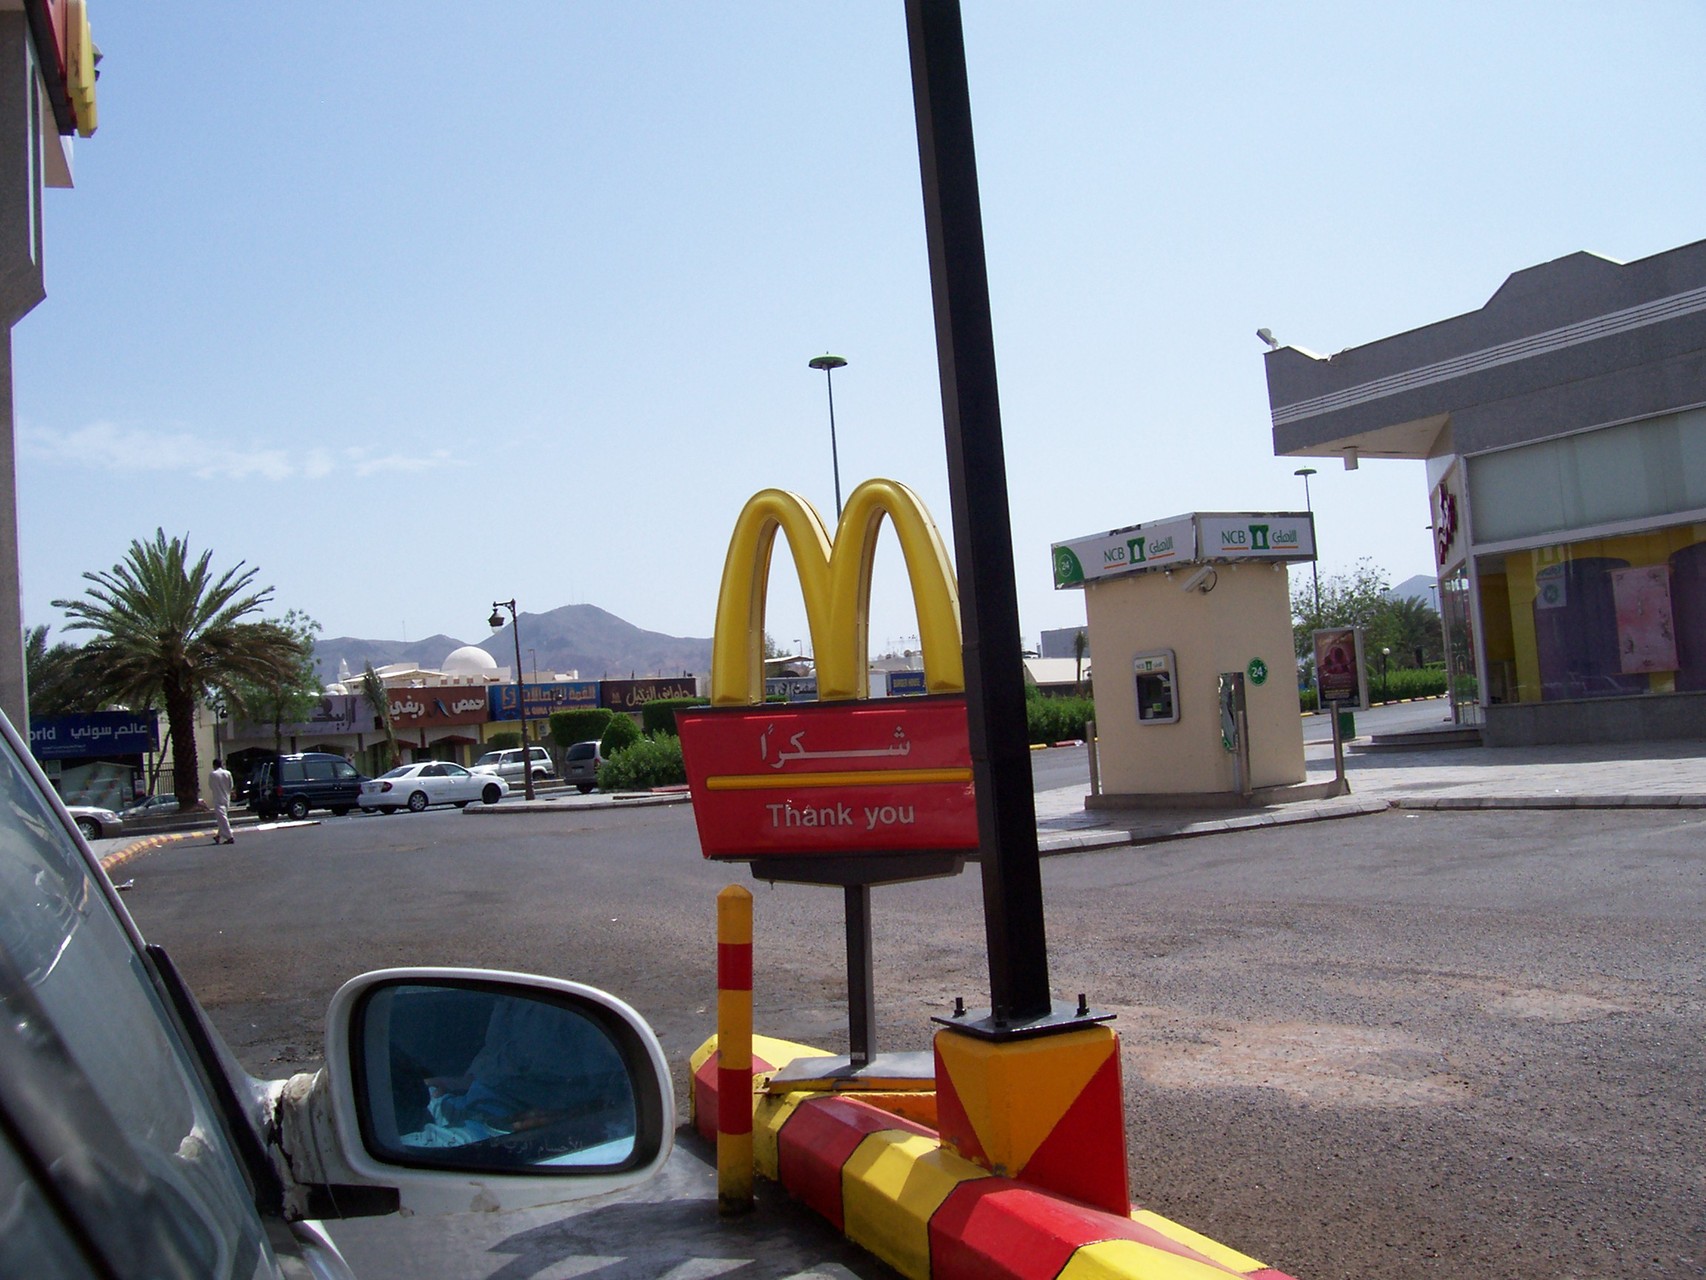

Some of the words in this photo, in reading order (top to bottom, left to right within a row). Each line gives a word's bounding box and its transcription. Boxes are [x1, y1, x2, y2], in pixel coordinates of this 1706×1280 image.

[1221, 530, 1246, 544] NCB
[1103, 546, 1126, 563] NCB
[1251, 667, 1263, 677] 24
[389, 695, 425, 720] ريفي
[452, 698, 485, 714] حمص
[30, 726, 56, 741] orld
[70, 725, 112, 740] سوني
[114, 723, 148, 740] عالم
[765, 802, 853, 828] Thank
[863, 804, 916, 831] you
